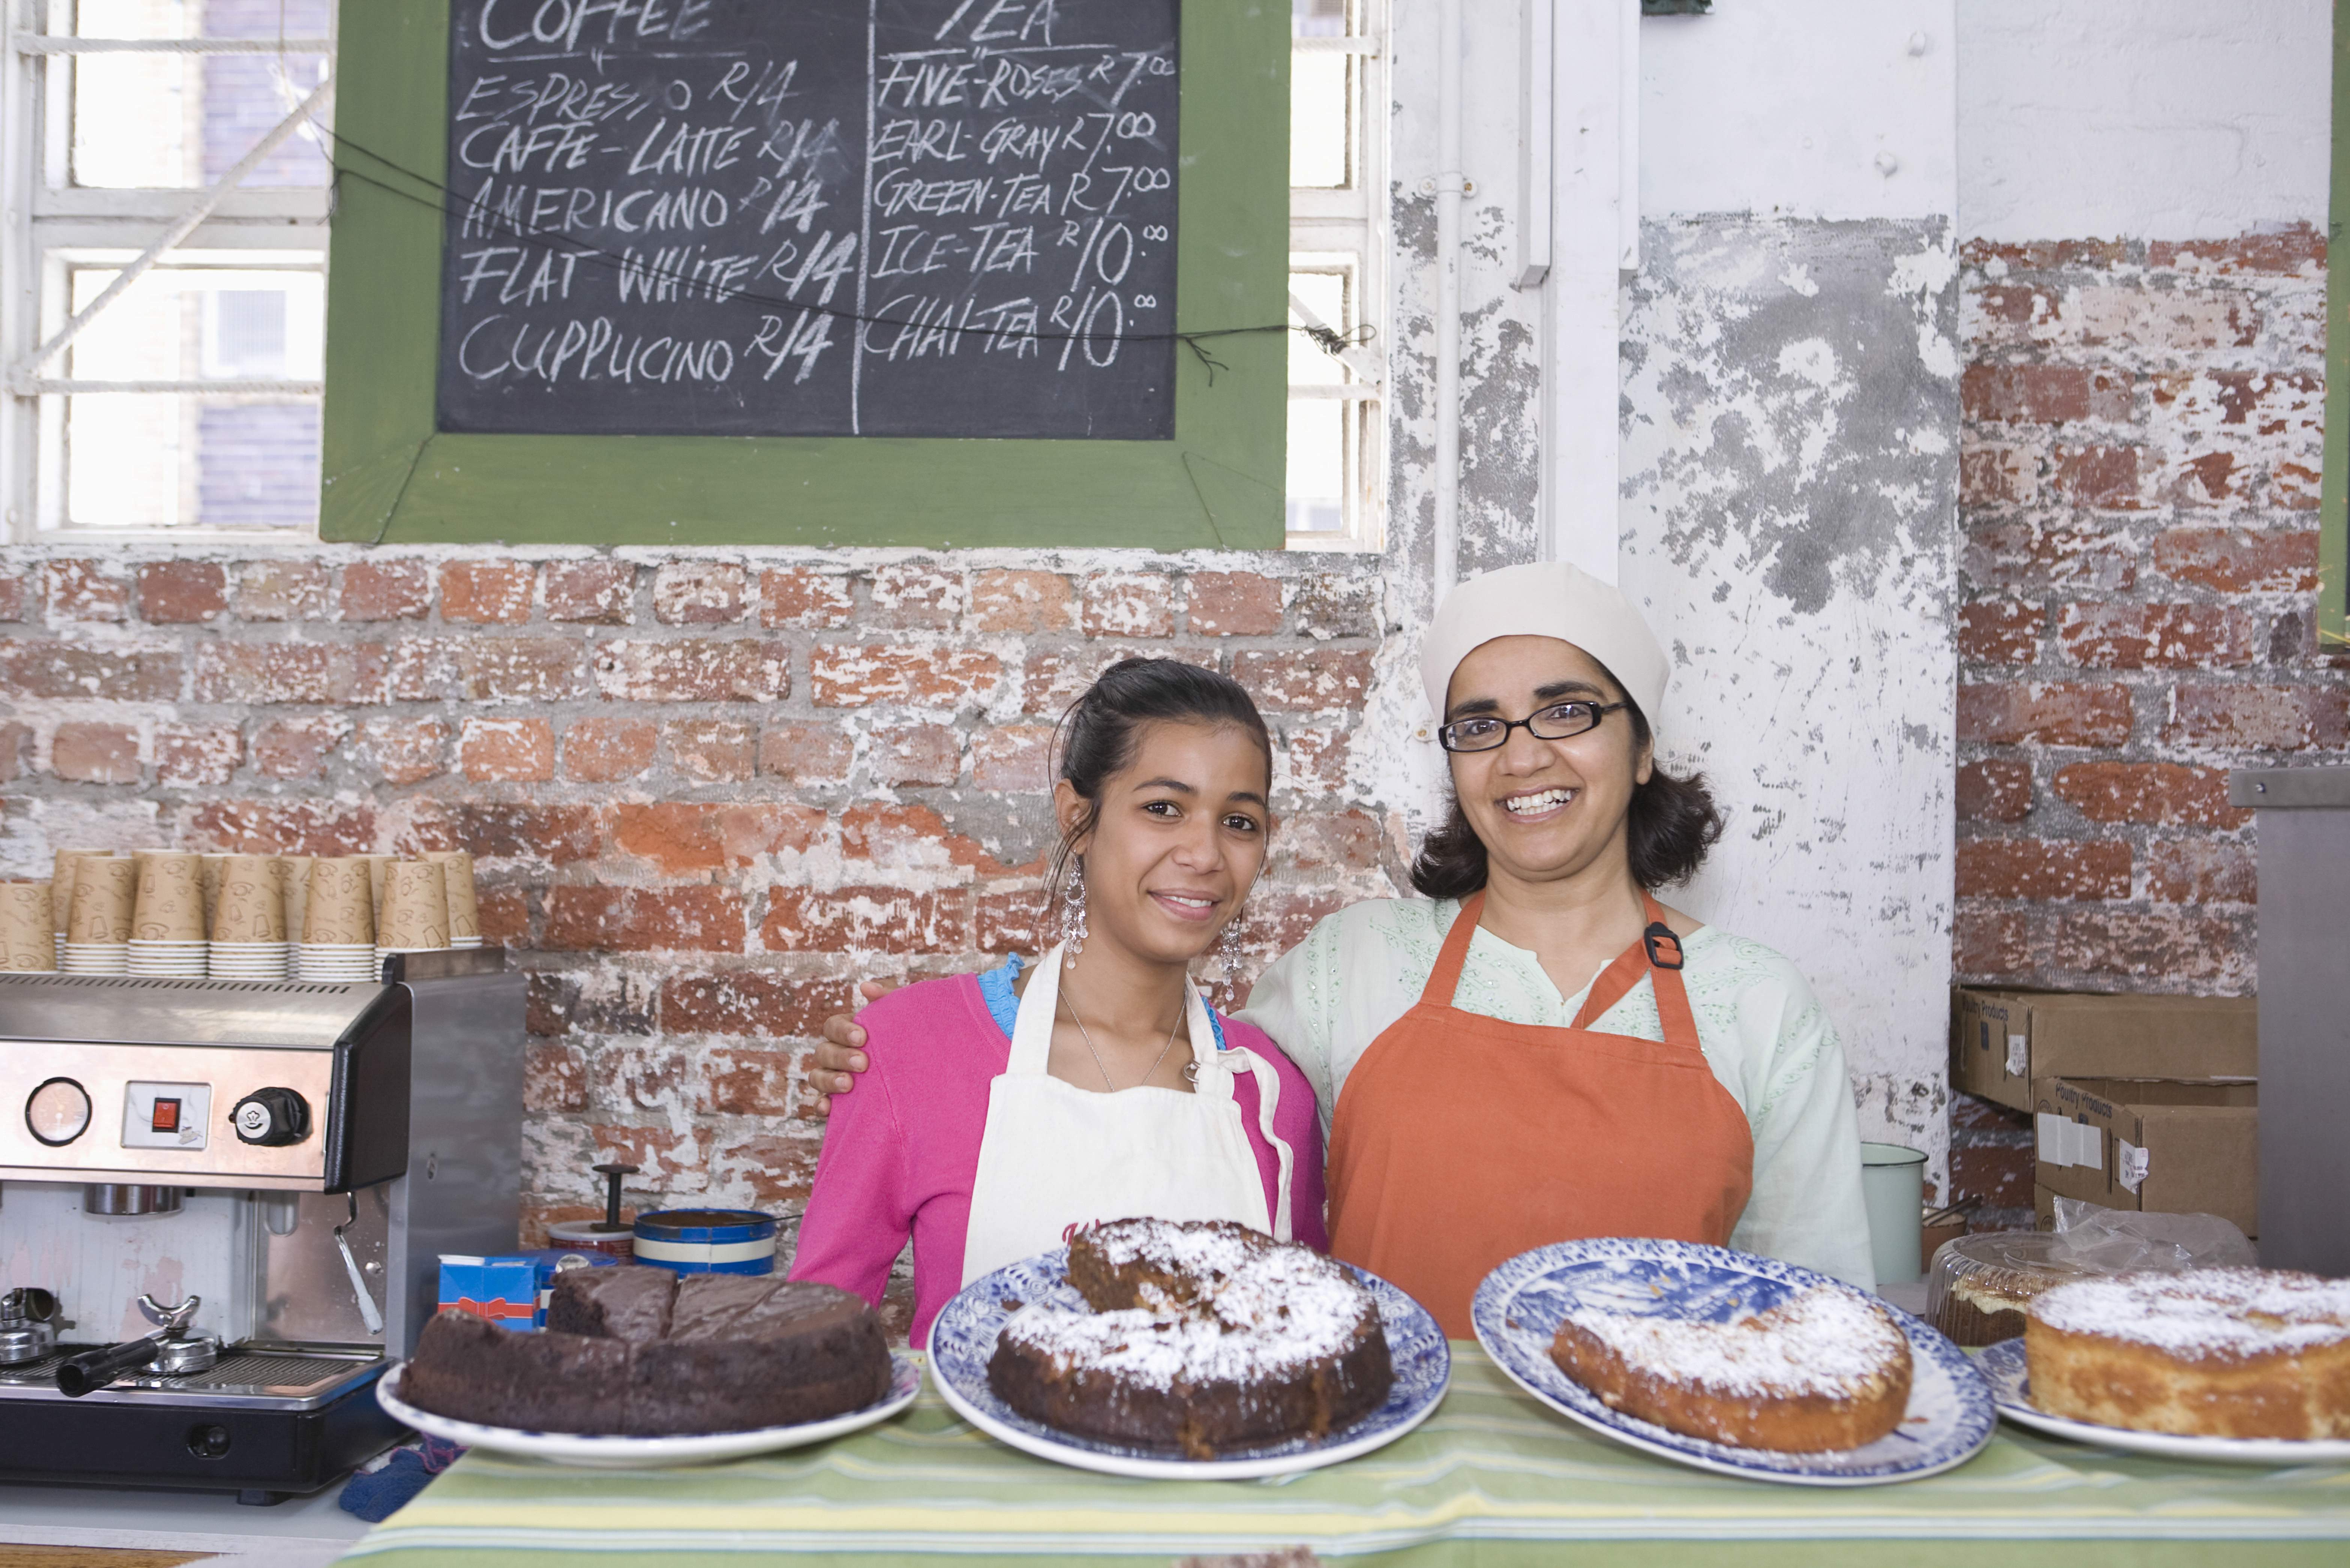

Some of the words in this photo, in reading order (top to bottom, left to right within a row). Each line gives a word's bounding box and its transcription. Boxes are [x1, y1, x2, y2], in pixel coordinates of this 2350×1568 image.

[462, 176, 728, 239] AMERICANO
[460, 246, 601, 306] FLAT
[459, 314, 734, 384] CUPPUCINO
[2055, 1082, 2080, 1110] Poultry
[2081, 1092, 2113, 1119] Products
